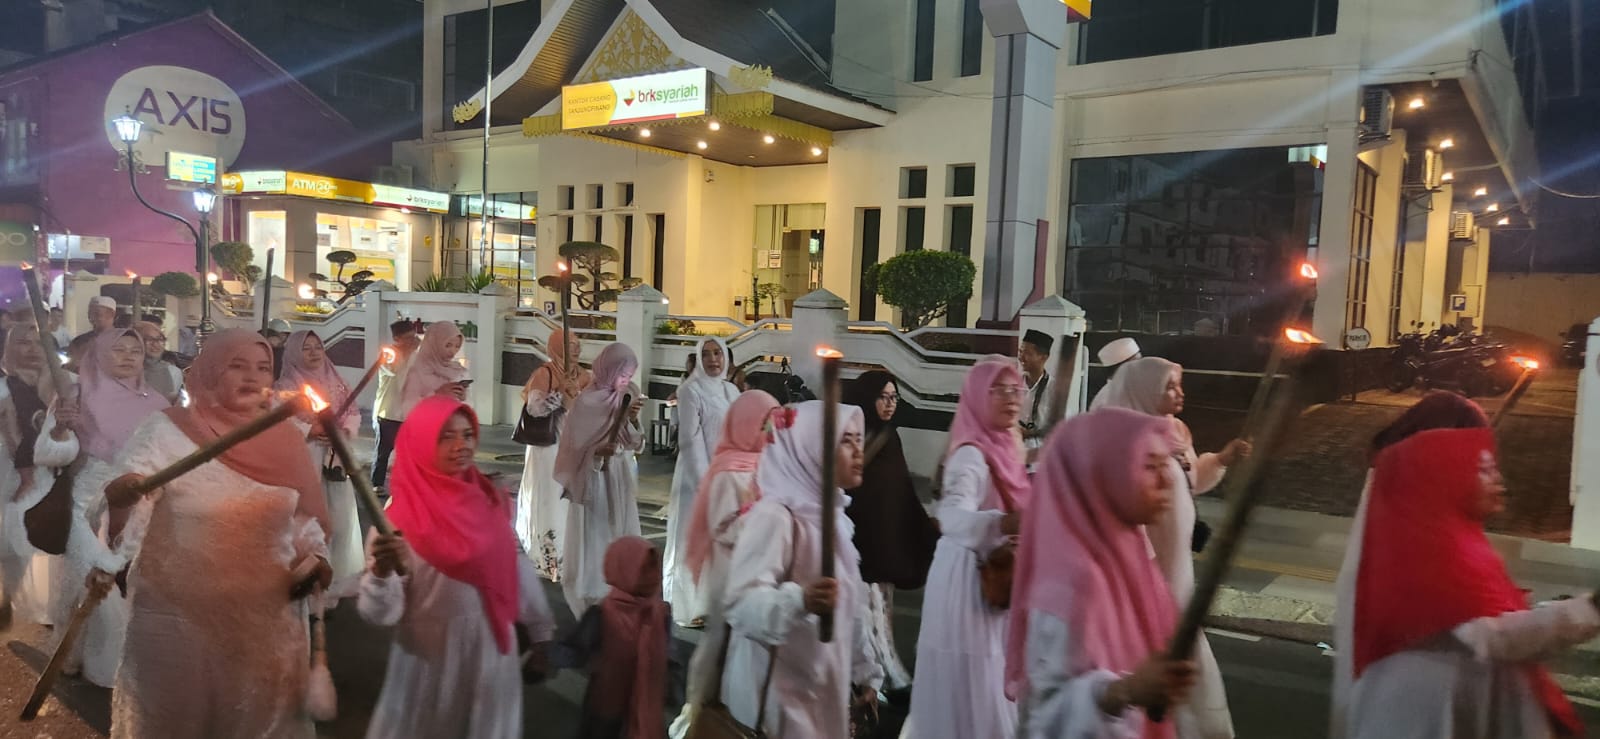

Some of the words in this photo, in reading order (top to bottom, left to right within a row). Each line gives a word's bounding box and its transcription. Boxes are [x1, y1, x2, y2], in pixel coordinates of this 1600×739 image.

[638, 83, 699, 104] brksyariah
[131, 87, 232, 135] AXIS
[292, 178, 317, 191] ATM
